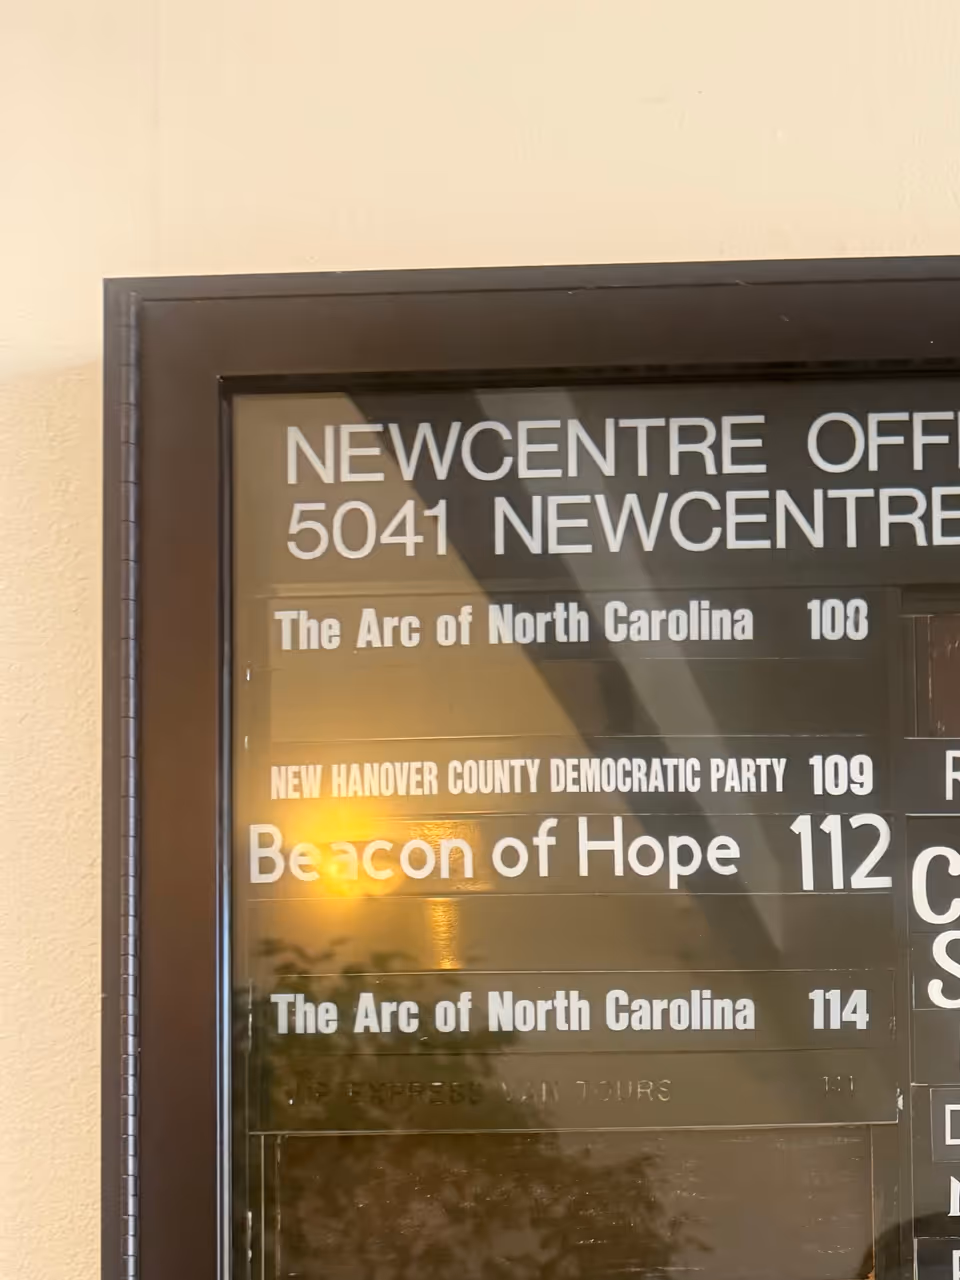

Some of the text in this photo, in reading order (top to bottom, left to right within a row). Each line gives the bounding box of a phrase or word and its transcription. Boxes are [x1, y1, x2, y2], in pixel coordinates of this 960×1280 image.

[287, 416, 766, 484] NEWCENTRE
[287, 500, 446, 559] 5041
[275, 599, 868, 650] The Arc of North Carolina 108
[271, 754, 873, 799] NEW HANOVER COUNTY DEMOCRATIC PARTY 109
[250, 814, 892, 890] Beacon of Hope 112
[271, 989, 869, 1034] The Arc of North Carolina 114
